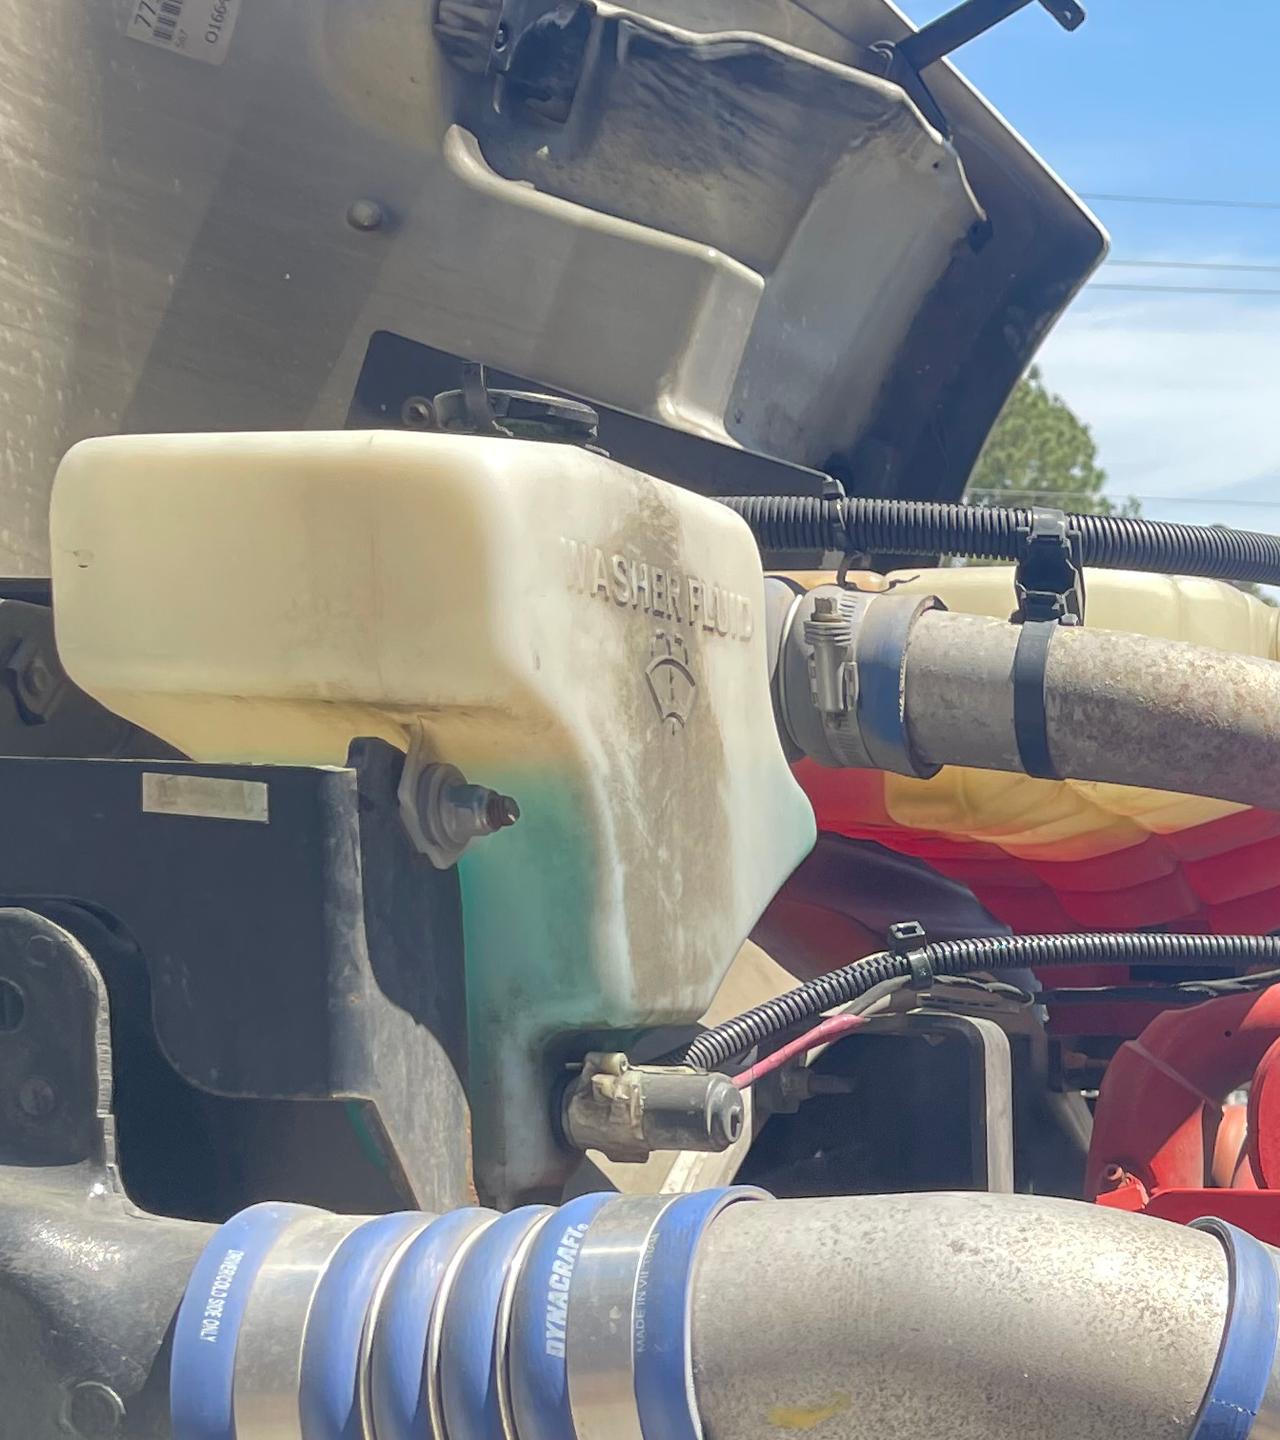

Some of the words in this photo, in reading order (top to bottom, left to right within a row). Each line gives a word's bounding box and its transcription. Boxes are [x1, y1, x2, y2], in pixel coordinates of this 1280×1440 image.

[560, 537, 682, 623] WASHER
[687, 574, 752, 642] FLUID
[205, 1298, 225, 1318] SIDE
[201, 1319, 220, 1343] ONLY
[636, 1310, 647, 1352] MADE
